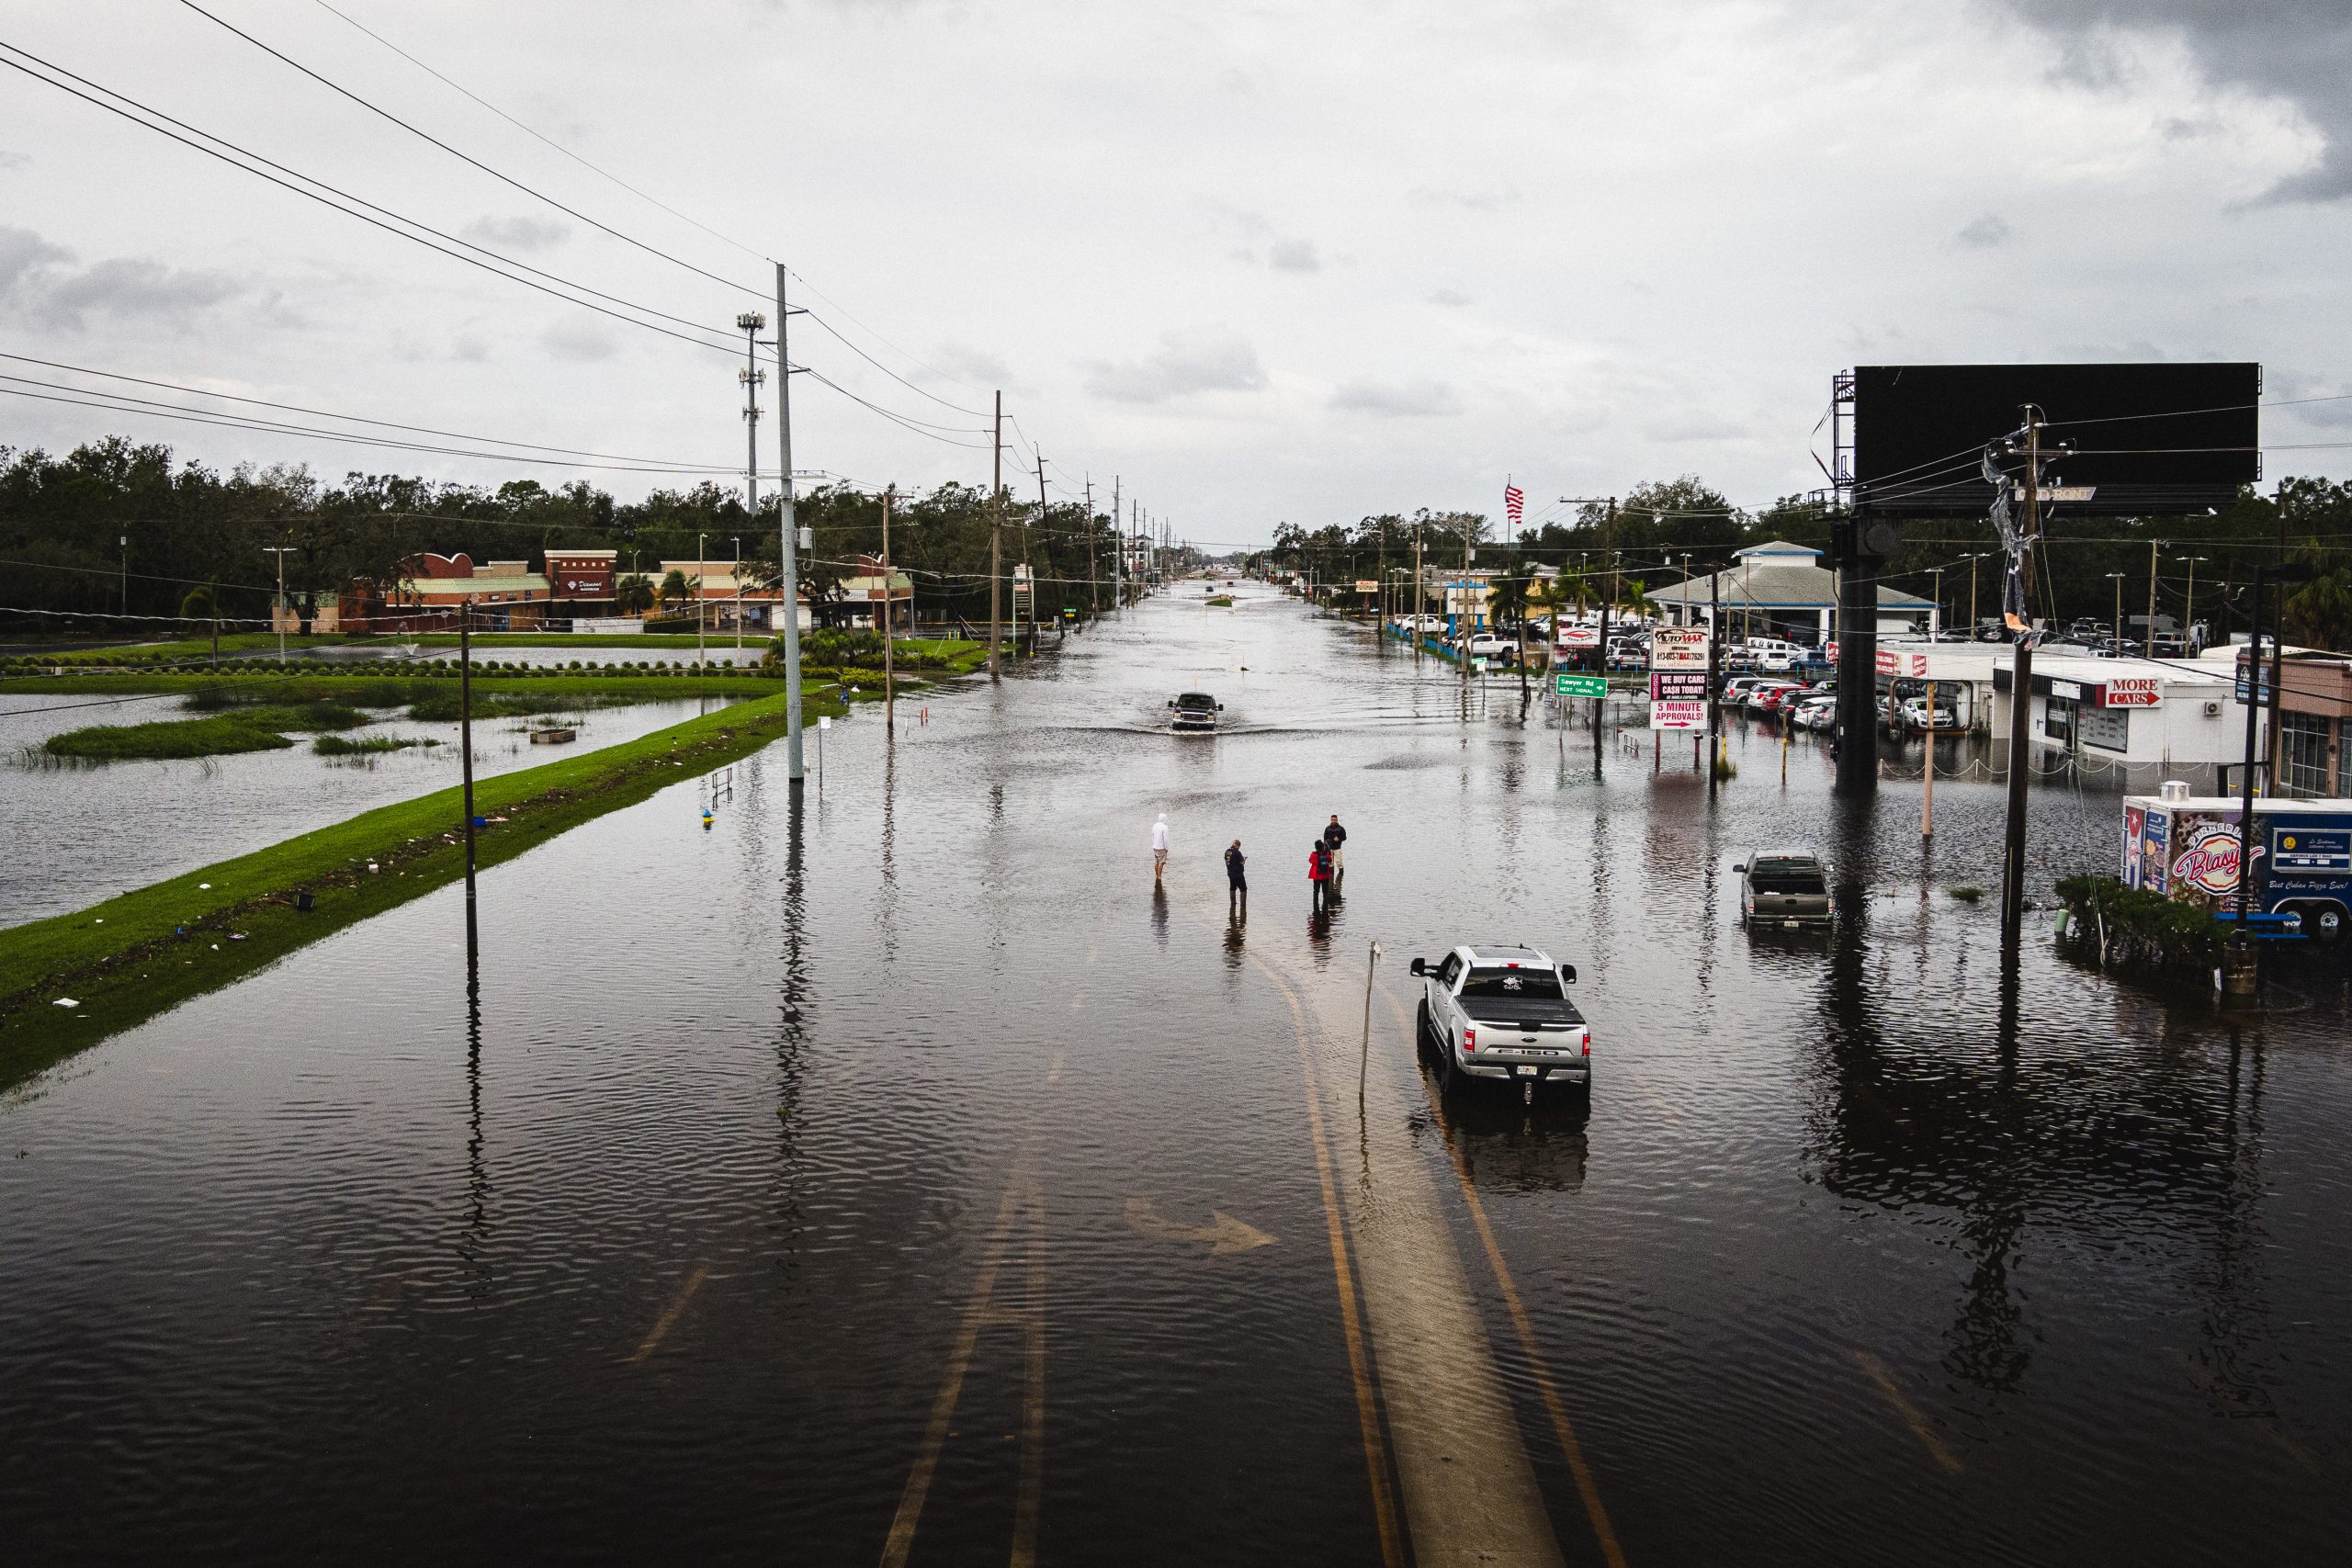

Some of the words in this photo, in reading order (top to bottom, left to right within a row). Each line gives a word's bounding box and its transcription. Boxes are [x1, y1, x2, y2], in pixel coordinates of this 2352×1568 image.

[2018, 489, 2090, 499] OTRONT
[1560, 678, 1582, 687] Sawyer
[1661, 675, 1672, 684] WE
[1673, 675, 1686, 684] BUY
[1688, 675, 1705, 684] CARS
[2113, 679, 2158, 691] MORE
[1681, 686, 1704, 694] TODAY!
[2114, 694, 2148, 704] CARS
[1657, 703, 1664, 711] 5
[1666, 703, 1702, 711] MINUTE
[1656, 713, 1703, 721] APPROVALS!
[2285, 880, 2306, 890] Cuban
[2308, 882, 2326, 891] Pizza
[2329, 882, 2348, 890] Ever!
